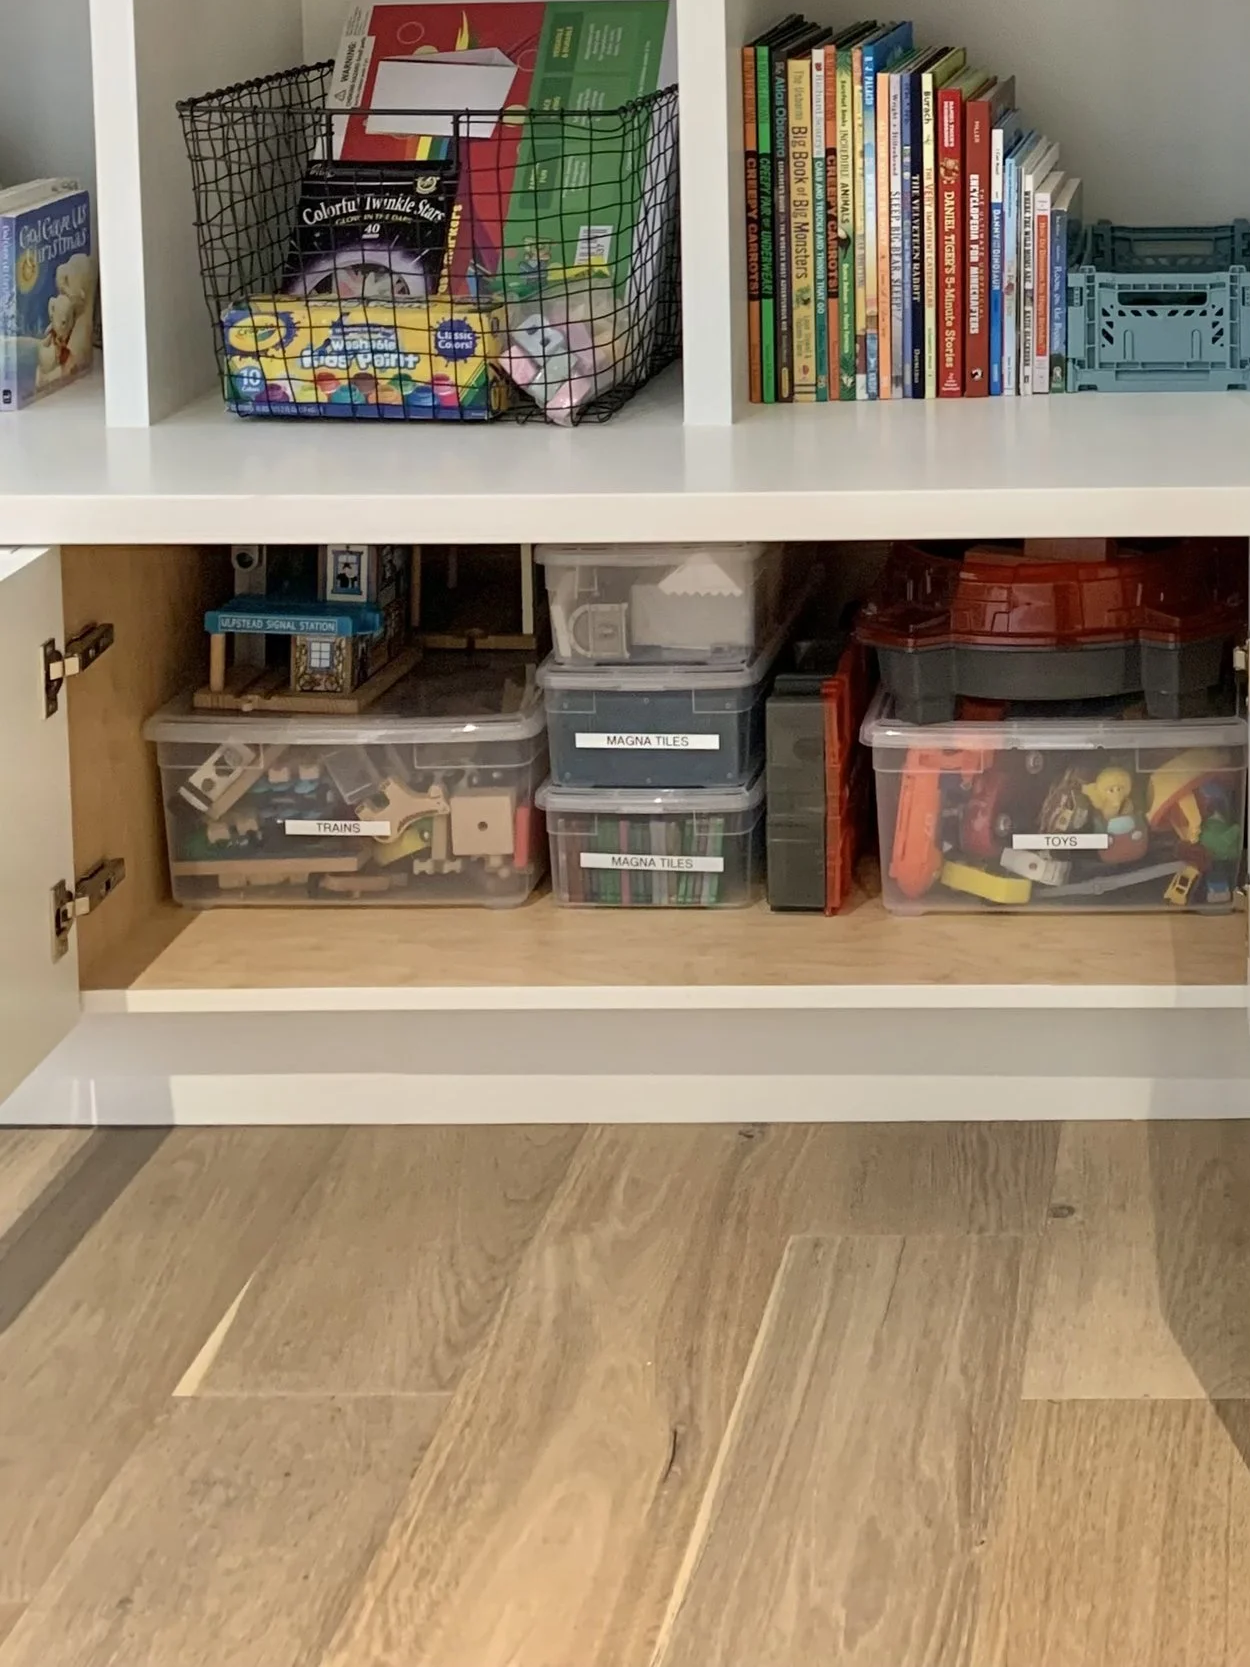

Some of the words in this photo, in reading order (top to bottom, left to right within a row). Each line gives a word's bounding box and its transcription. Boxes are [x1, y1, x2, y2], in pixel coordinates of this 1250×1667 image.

[774, 76, 786, 106] Atlas
[864, 76, 874, 106] PALACIO
[923, 91, 933, 125] Burach
[775, 107, 787, 158] Obscura
[792, 126, 808, 148] Big
[839, 129, 849, 178] INCREDIBLE
[760, 158, 772, 195] CREEPY
[792, 151, 808, 185] Book
[815, 161, 824, 181] CARS
[746, 158, 758, 219] CREEPY
[796, 187, 805, 196] of
[815, 184, 825, 199] AND
[826, 155, 837, 220] CREEPY
[911, 174, 920, 197] THE
[924, 184, 933, 207] VERY
[302, 197, 360, 226] Colorful
[364, 193, 415, 213] Twinkle
[414, 197, 446, 224] Stars
[761, 196, 773, 216] PAIR
[792, 199, 809, 219] Big
[815, 201, 826, 233] TRUCKS
[840, 183, 851, 224] ANIMALS
[944, 191, 955, 232] DANIEL
[969, 174, 980, 241] ENCYCLOPEDIA
[19, 219, 42, 248] God
[364, 223, 381, 234] 40
[890, 226, 901, 243] BIG
[911, 198, 920, 261] VELVETEEN
[992, 208, 1001, 239] DANNY
[793, 222, 810, 280] Monsters
[816, 234, 826, 250] AND
[944, 234, 956, 275] TIGER'S
[969, 244, 979, 263] FOR
[747, 222, 759, 294] CARROTS!
[761, 230, 774, 294] UNDERWEAR!
[816, 252, 826, 280] THINGS
[827, 221, 839, 293] CARROTS!
[992, 249, 1000, 291] DINOSAUR
[816, 282, 827, 301] THAT
[912, 263, 921, 302] RABBIT
[1054, 266, 1063, 291] Room
[817, 302, 827, 314] GO
[944, 276, 955, 327] 5-Minute
[969, 266, 980, 334] MINECRAFTERS
[1054, 293, 1060, 306] on
[1054, 307, 1064, 320] the
[331, 337, 397, 351] Washable
[437, 331, 473, 341] Classic
[437, 340, 473, 350] Colors!
[945, 329, 955, 368] Stories
[1053, 322, 1062, 351] Broom
[354, 352, 420, 370] Paint
[240, 368, 261, 386] 10
[266, 620, 297, 630] SIGNAL
[299, 622, 335, 632] STATION
[606, 734, 652, 748] MAGNA
[655, 734, 690, 748] TILES
[315, 821, 362, 835] TRAINS
[1044, 835, 1078, 849] TOYS
[611, 854, 654, 868] MAGNA
[657, 856, 694, 870] TILES
